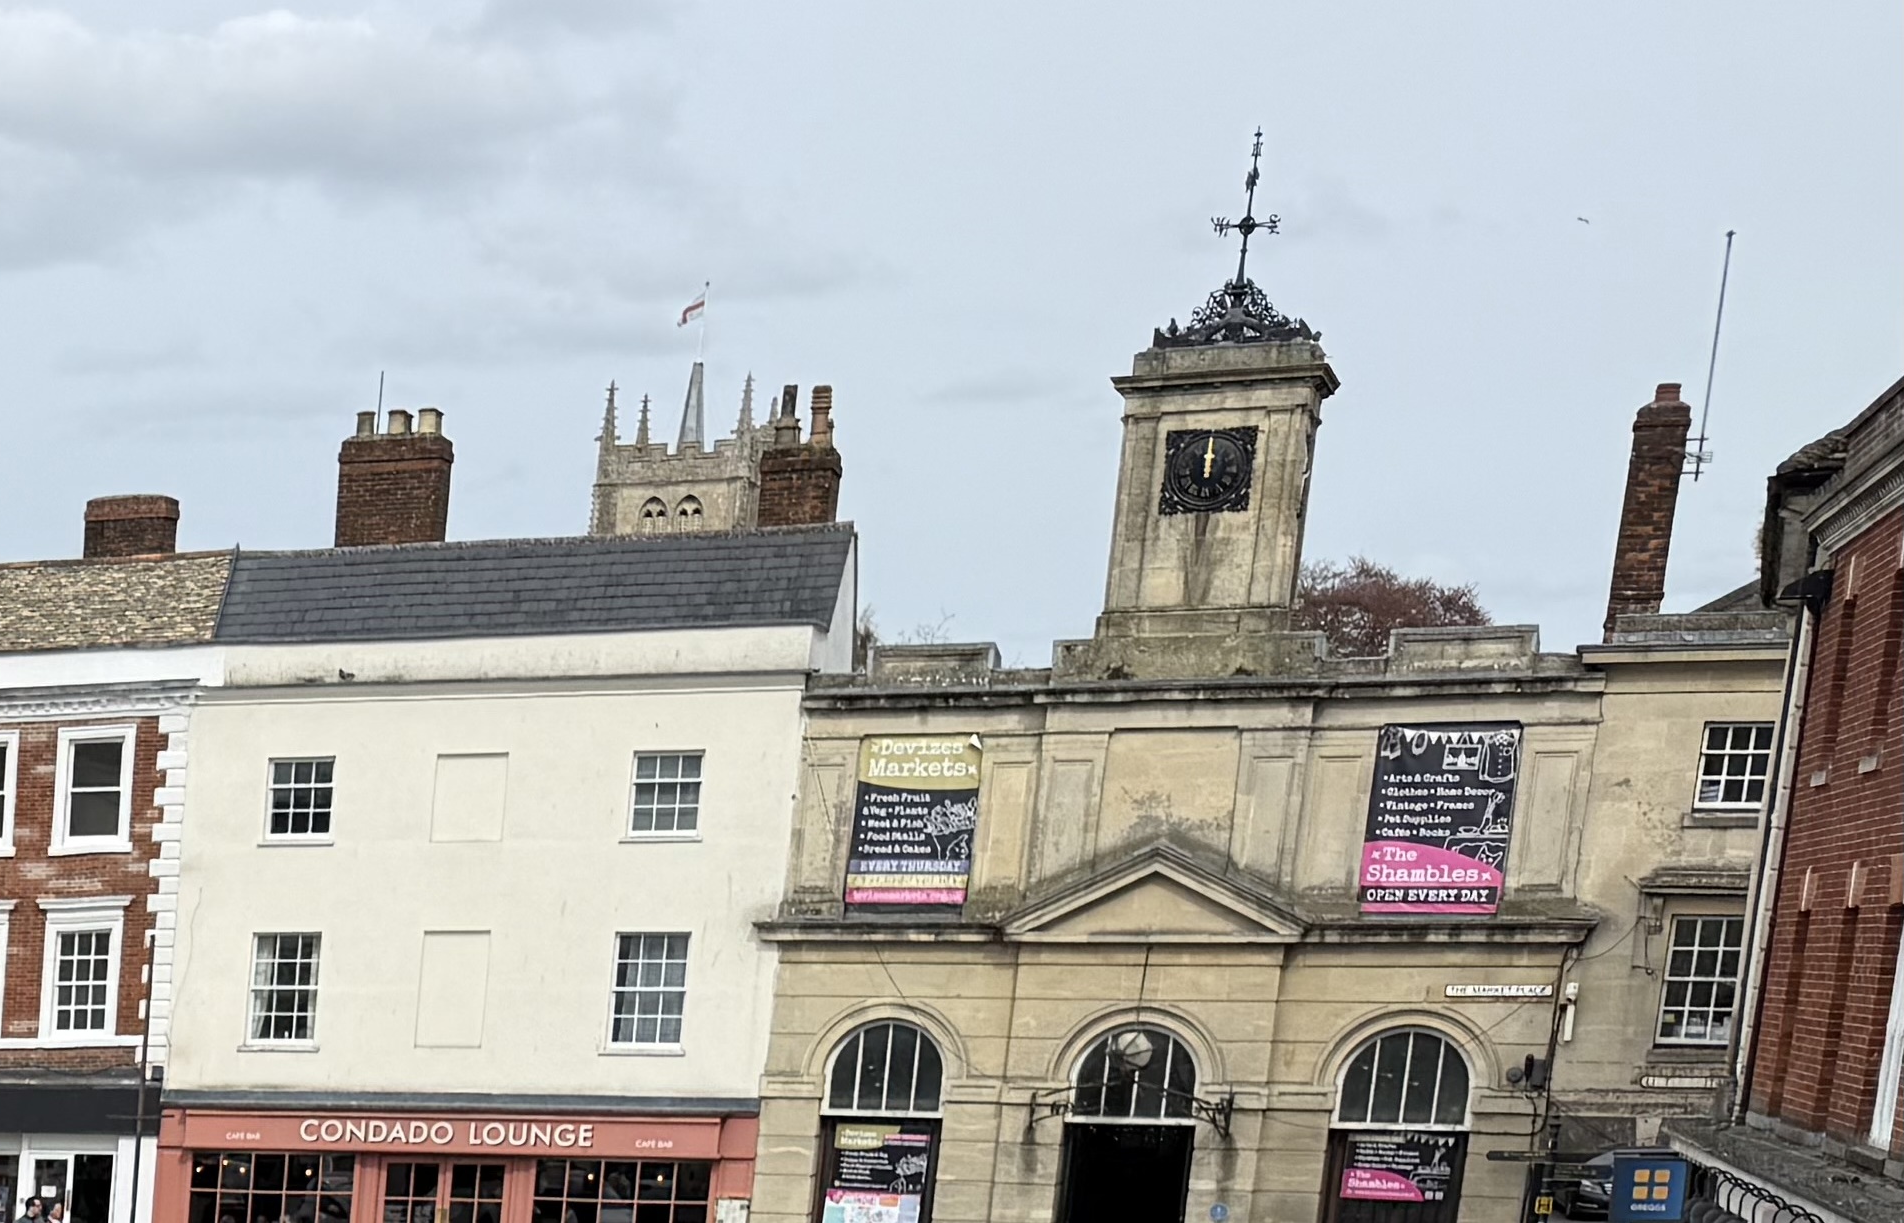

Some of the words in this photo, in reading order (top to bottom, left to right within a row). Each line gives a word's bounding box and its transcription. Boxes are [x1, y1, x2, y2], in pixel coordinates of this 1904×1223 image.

[881, 739, 964, 755] Devizes
[868, 757, 967, 777] Markets
[1388, 774, 1412, 782] Arts
[1423, 773, 1460, 782] Crafts
[870, 792, 900, 803] Fresh
[901, 792, 931, 803] Fruit
[1386, 787, 1428, 796] Clothes
[1436, 787, 1462, 796] Home
[894, 805, 928, 815] Plants
[1386, 801, 1428, 811] Vintage
[1436, 801, 1475, 810] Frames
[1403, 814, 1452, 825] Supplies
[1383, 847, 1417, 861] The
[860, 860, 899, 872] EVERY
[901, 860, 962, 872] THURSDAY
[1366, 864, 1479, 882] Shambles
[1366, 889, 1404, 901] OPEN
[1408, 889, 1458, 902] EVERY
[1461, 889, 1489, 902] DAY
[300, 1119, 454, 1144] CONDADO
[469, 1122, 593, 1147] LOUNGE
